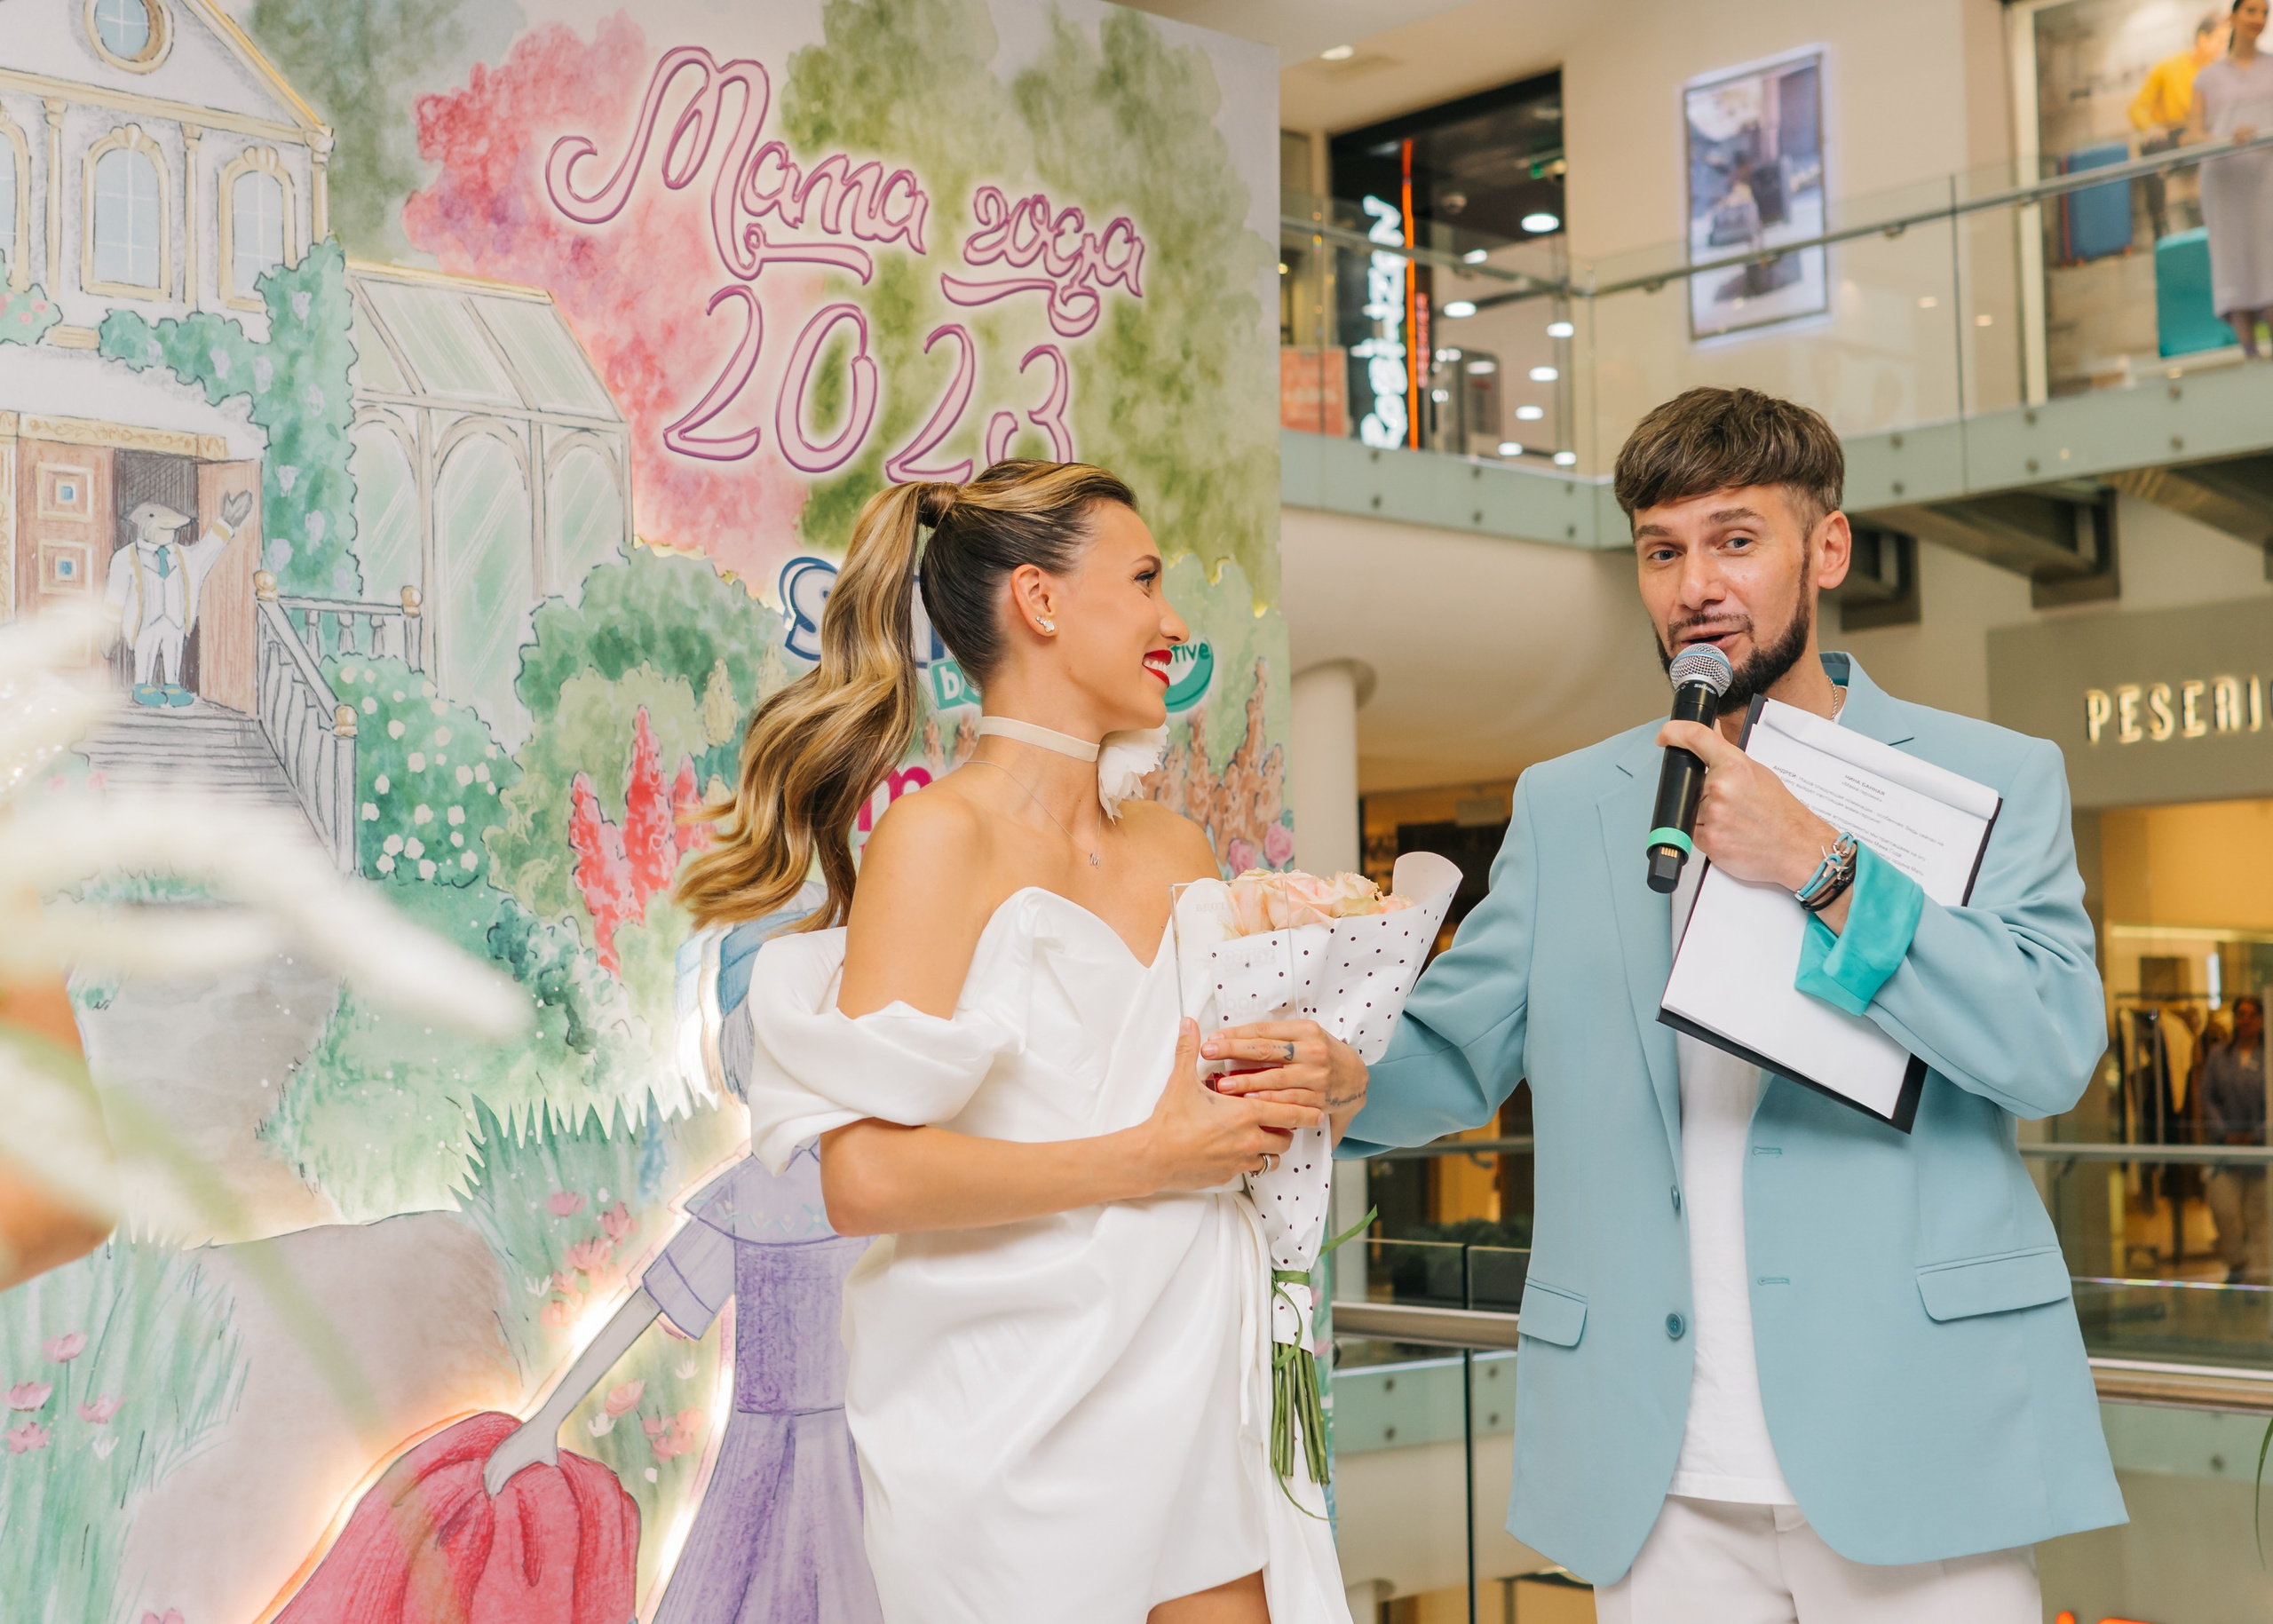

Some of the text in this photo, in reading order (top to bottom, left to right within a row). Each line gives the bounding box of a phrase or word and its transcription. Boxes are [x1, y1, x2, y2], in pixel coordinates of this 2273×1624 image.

[664, 285, 1073, 483] 2023
[2085, 675, 2273, 744] PESERI
[1844, 774, 1885, 796] НИНА БАННАЯ
